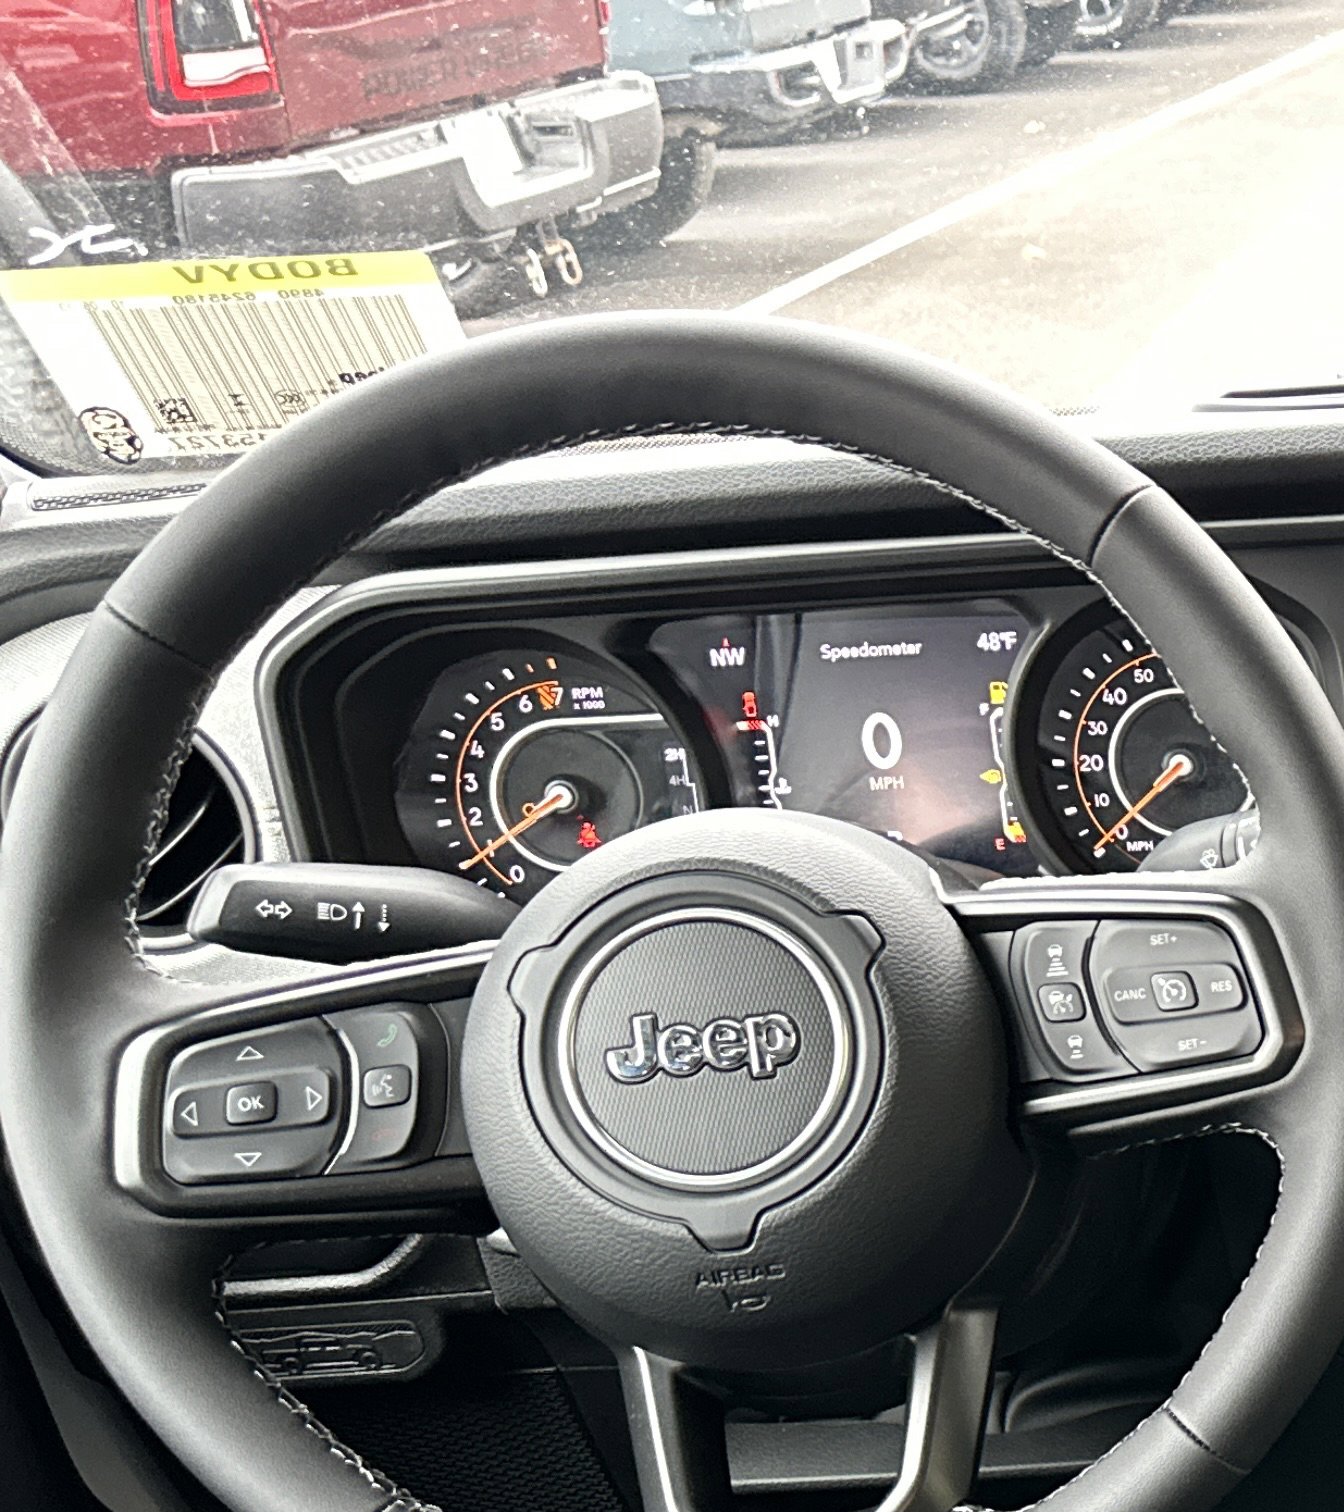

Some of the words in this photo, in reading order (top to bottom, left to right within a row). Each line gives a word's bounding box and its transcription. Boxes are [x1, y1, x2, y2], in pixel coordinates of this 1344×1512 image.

[709, 647, 746, 667] NW
[820, 640, 922, 662] Speedometer
[1134, 668, 1154, 684] 50
[571, 686, 604, 699] RPM
[1102, 687, 1127, 706] 40
[518, 693, 533, 713] 6
[489, 711, 505, 731] 5
[1088, 720, 1108, 736] 30
[861, 711, 902, 770] 0
[469, 741, 485, 760] 4
[664, 748, 685, 762] 2H
[1079, 754, 1104, 772] 20
[464, 772, 479, 791] 3
[869, 775, 905, 791] MPH
[1094, 793, 1110, 808] 10
[468, 807, 483, 826] 2
[509, 864, 525, 883] 0
[1114, 987, 1147, 1001] CANC
[1211, 980, 1232, 993] RES
[604, 1011, 800, 1084] Jeep
[238, 1095, 265, 1112] OK
[694, 1263, 787, 1293] AIRBAG
